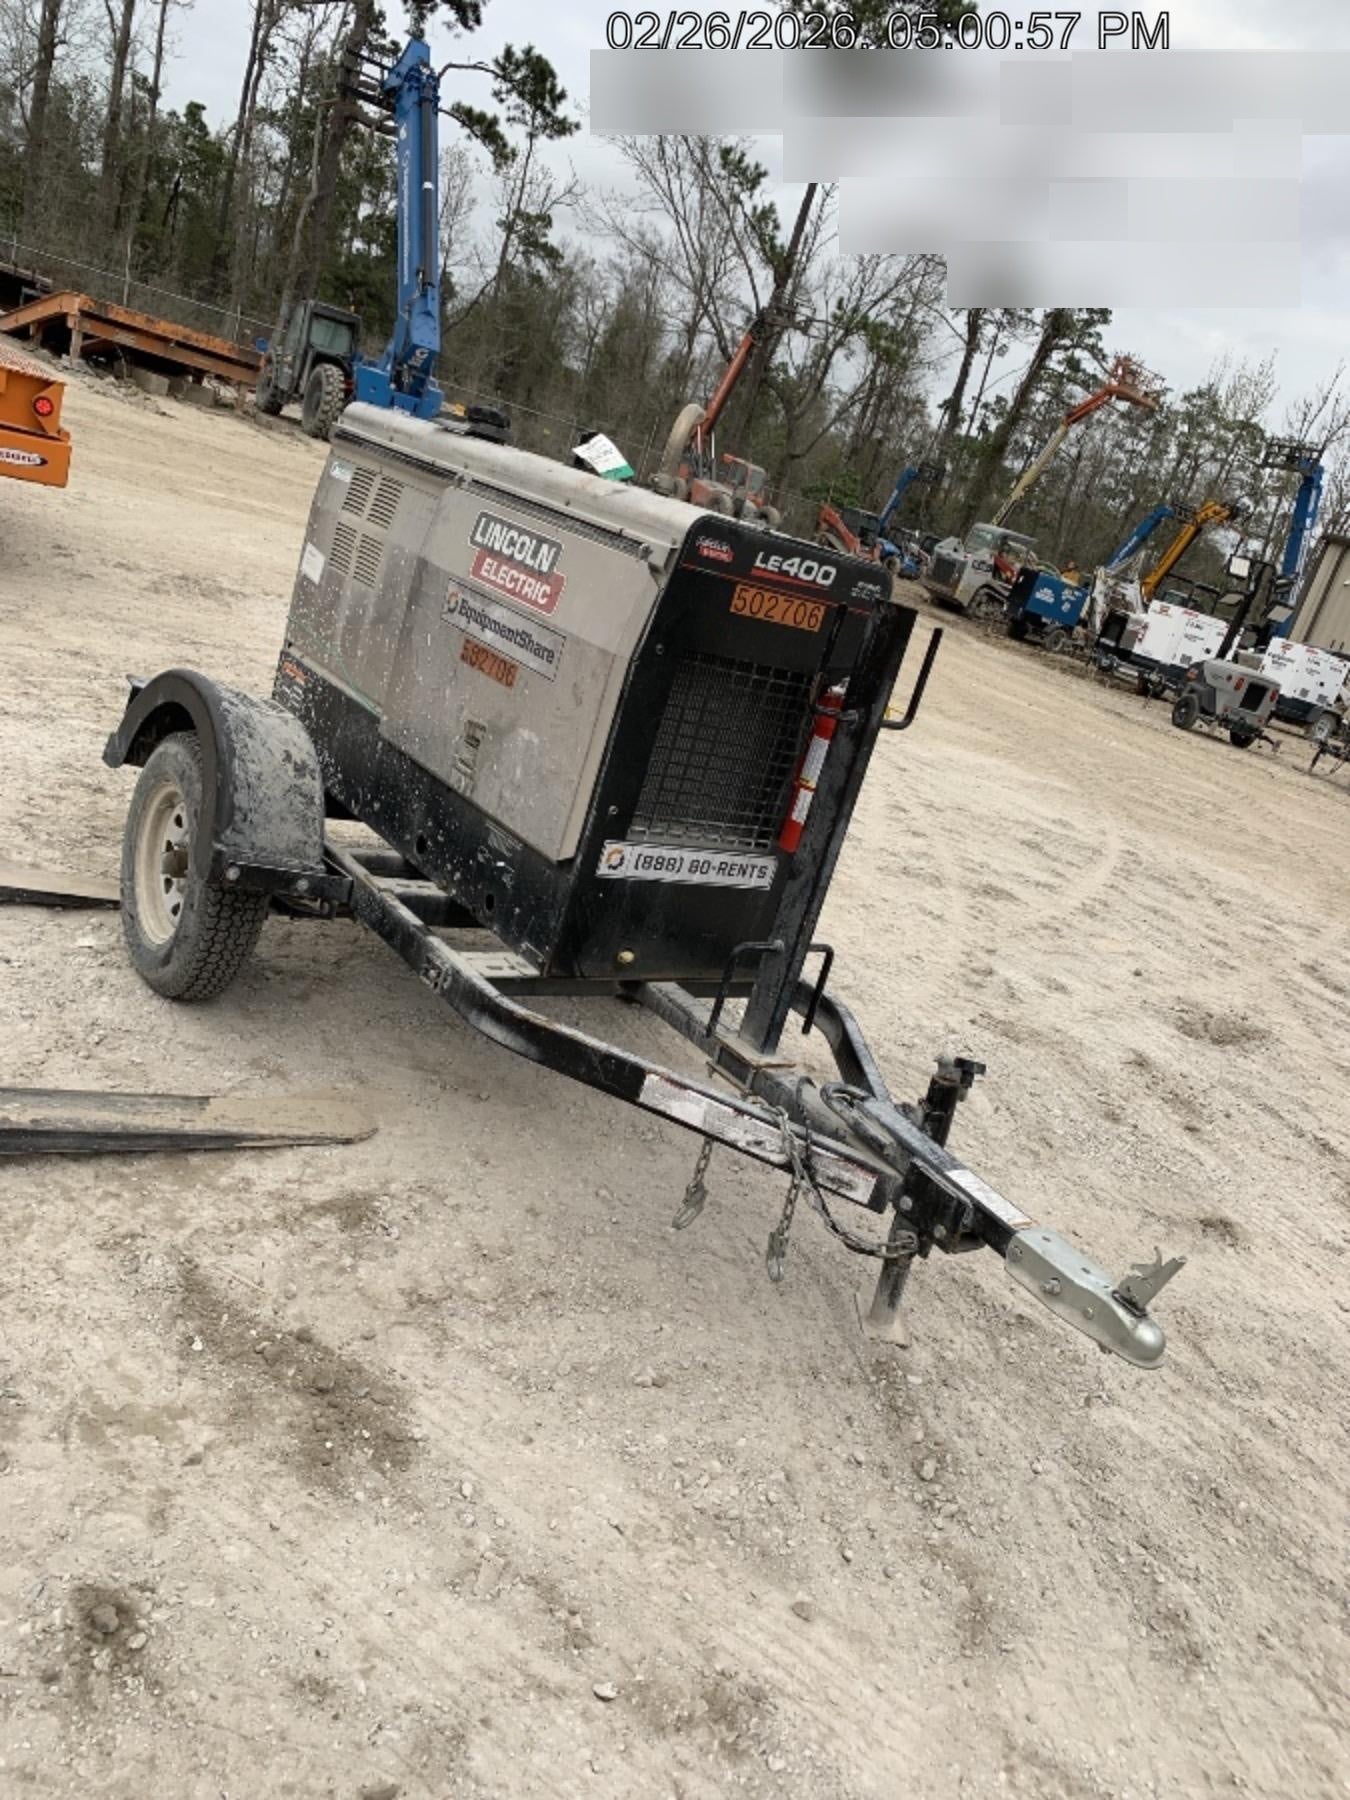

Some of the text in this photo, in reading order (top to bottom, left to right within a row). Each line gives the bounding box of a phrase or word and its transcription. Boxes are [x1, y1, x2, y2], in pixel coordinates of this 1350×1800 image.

[474, 517, 556, 572] LINCOLN
[479, 557, 551, 605] ELECTRIC
[755, 551, 837, 587] LE400
[458, 597, 555, 664] EquipmentShare
[733, 588, 820, 629] 502706
[634, 853, 684, 873] (888)
